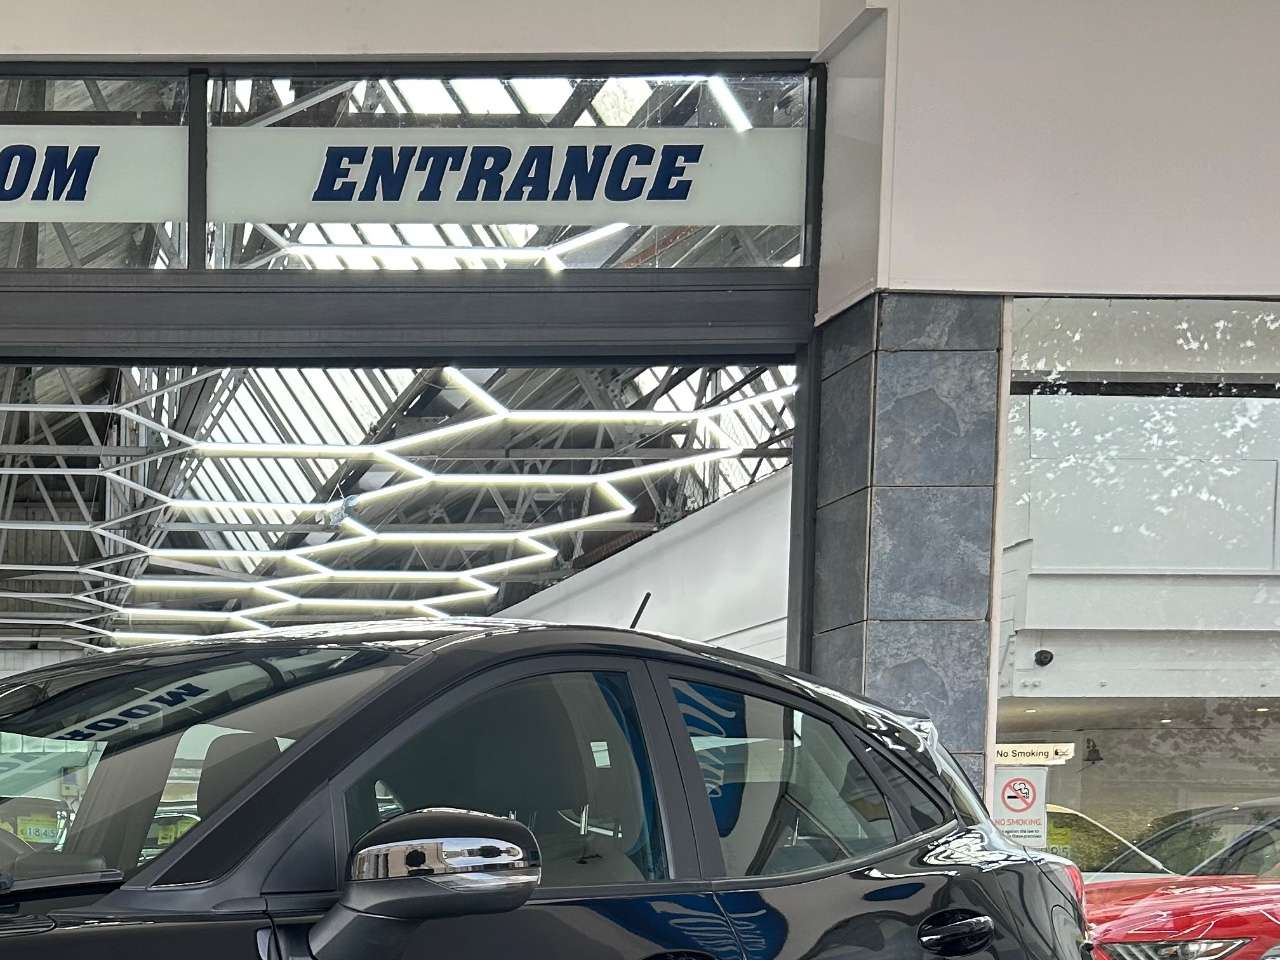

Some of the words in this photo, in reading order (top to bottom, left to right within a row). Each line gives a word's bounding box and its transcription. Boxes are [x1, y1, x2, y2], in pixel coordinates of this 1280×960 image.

[311, 144, 704, 202] ENTRANCE
[996, 749, 1009, 758] No
[1011, 749, 1049, 759] Smoking
